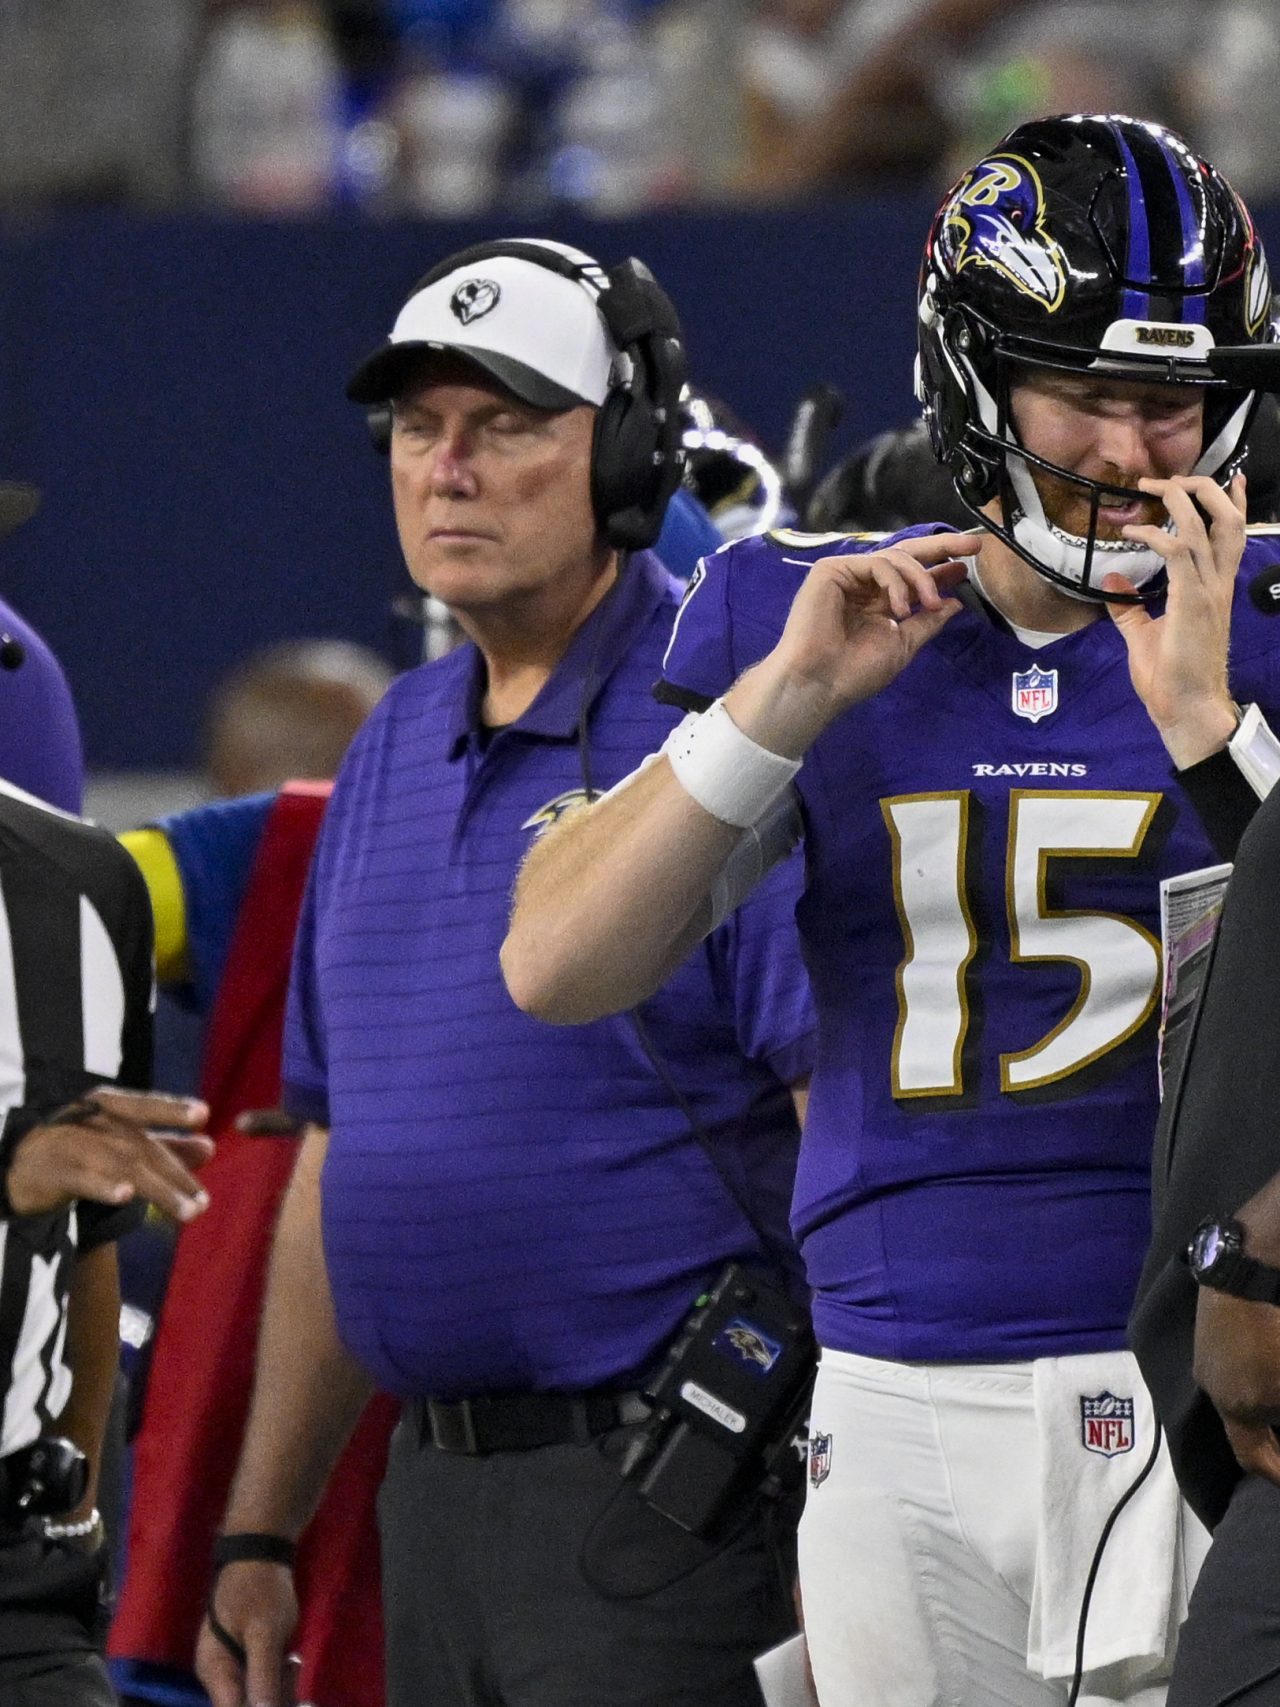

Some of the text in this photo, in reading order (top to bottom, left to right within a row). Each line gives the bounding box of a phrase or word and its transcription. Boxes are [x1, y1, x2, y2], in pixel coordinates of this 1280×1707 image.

[1135, 326, 1195, 348] RAVENS
[1020, 689, 1050, 711] NFL
[971, 763, 1087, 777] RAVENS
[879, 788, 1164, 1099] 15
[1087, 1420, 1129, 1451] NFL
